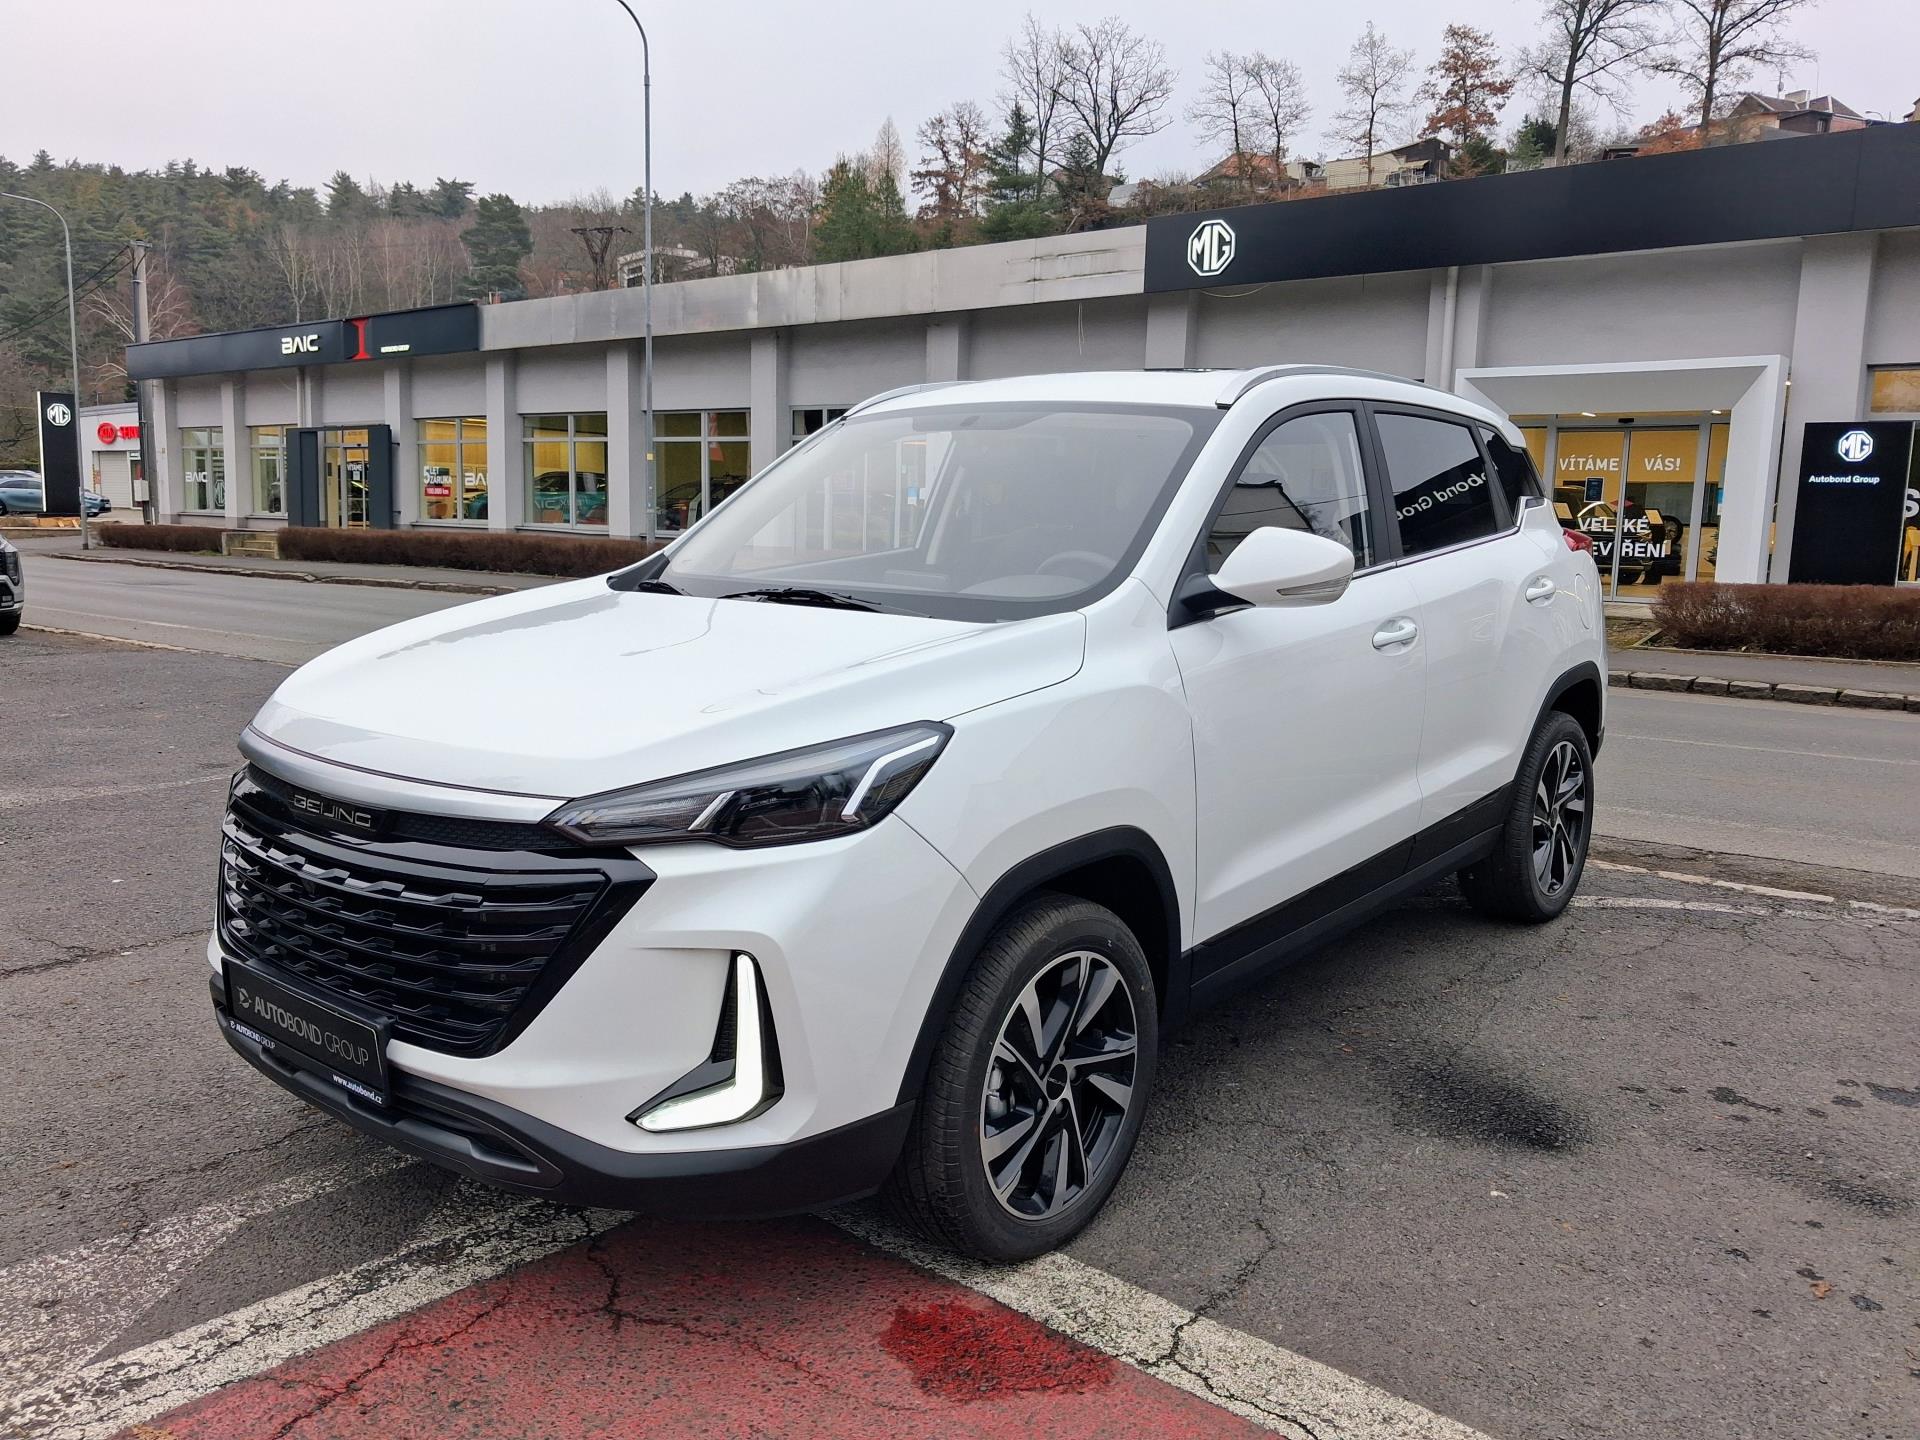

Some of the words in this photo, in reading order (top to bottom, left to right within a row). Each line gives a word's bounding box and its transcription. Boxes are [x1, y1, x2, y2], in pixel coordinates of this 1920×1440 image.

[1190, 223, 1233, 273] MG
[281, 334, 319, 355] BAIC
[48, 404, 70, 425] MG
[1840, 431, 1871, 460] MG
[1559, 455, 1620, 471] VÍTÁME
[1644, 454, 1681, 471] VÁS!
[185, 471, 208, 482] BAIC
[1808, 475, 1852, 484] Autobond
[1852, 475, 1880, 485] Group
[1577, 515, 1651, 533] VELKÉ
[294, 794, 371, 827] BEIJING
[254, 996, 322, 1045] AUTOBOND
[324, 1031, 369, 1066] GROUP
[332, 1074, 383, 1104] www.autobond.cz
